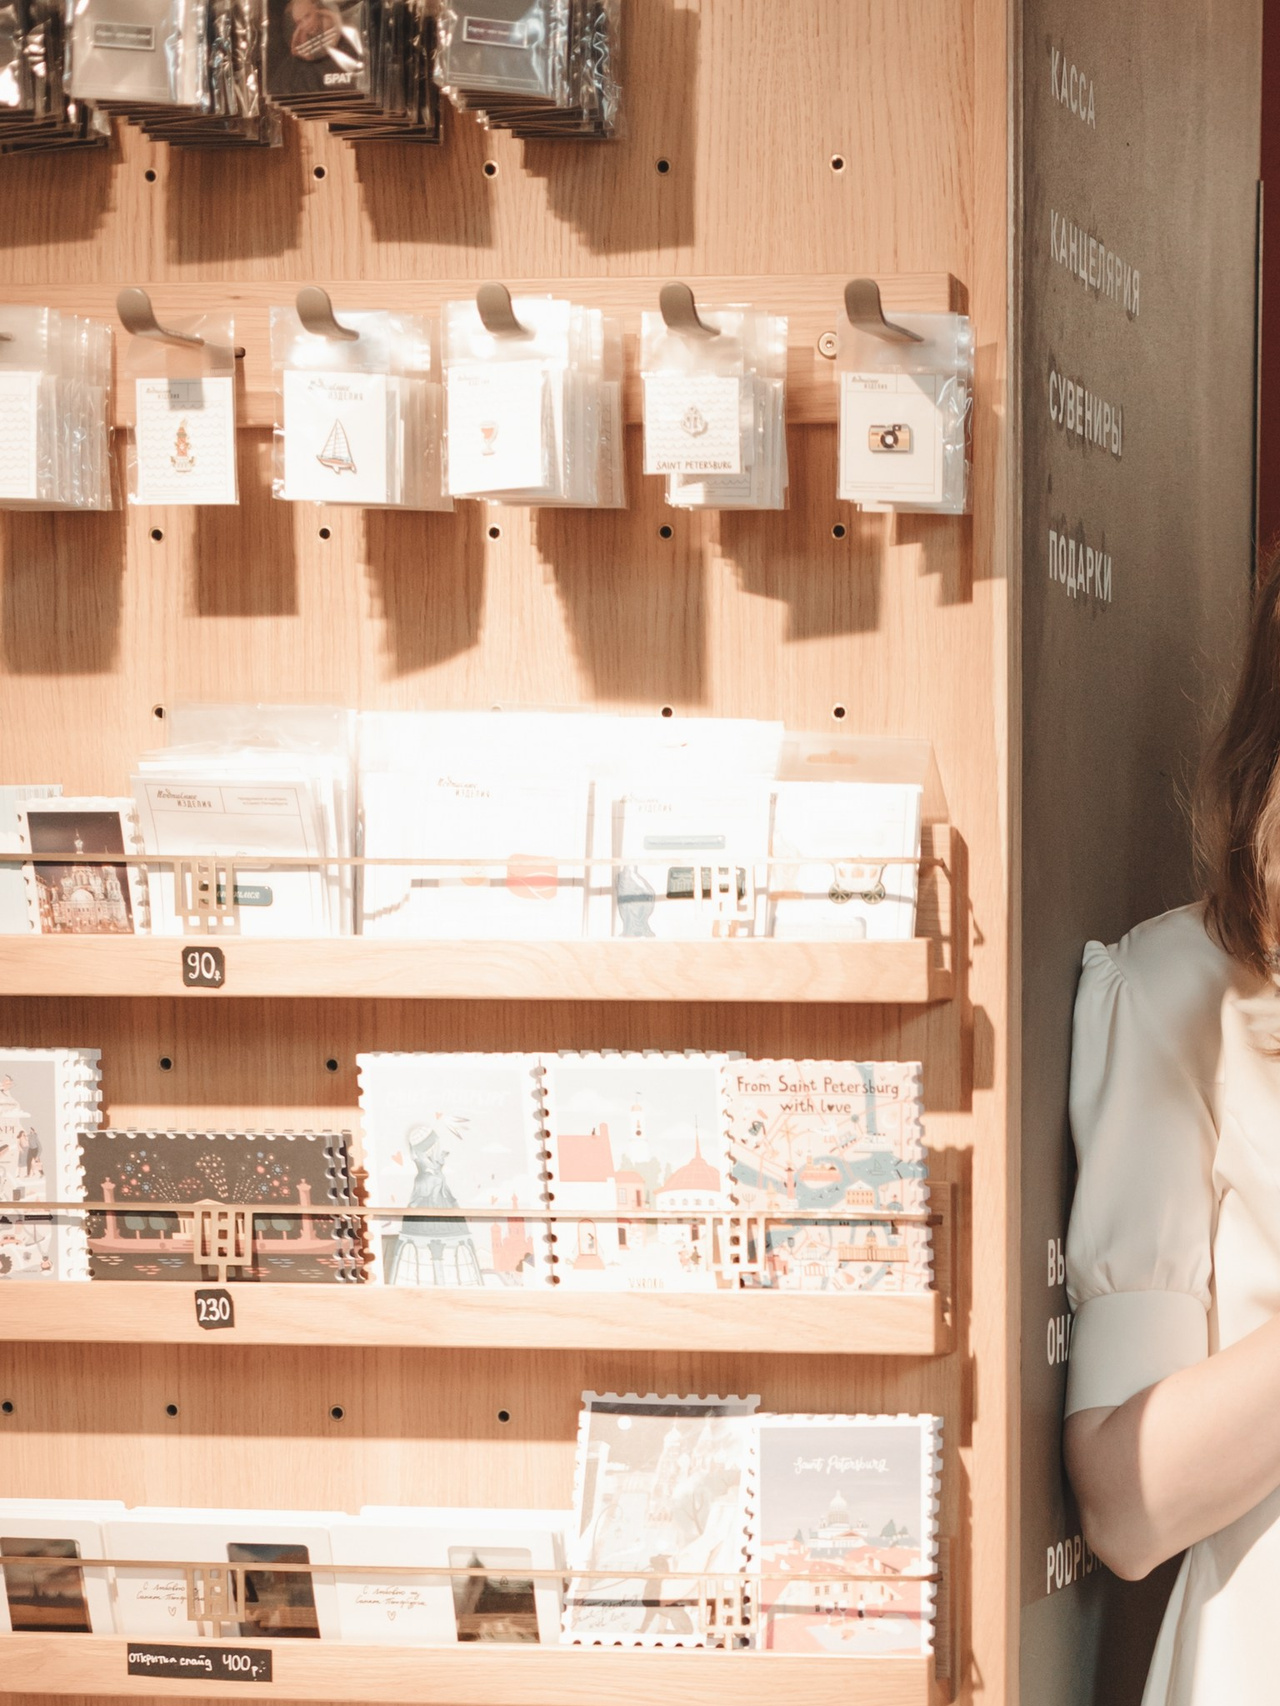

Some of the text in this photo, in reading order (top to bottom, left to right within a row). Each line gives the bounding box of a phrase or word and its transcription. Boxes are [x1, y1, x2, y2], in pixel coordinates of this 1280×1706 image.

[323, 72, 354, 86] БРАТ
[1051, 46, 1096, 129] КАССА
[1051, 209, 1140, 316] КАНЦЕЛЯРИЯ
[1049, 370, 1122, 456] СУВЕНИРЫ
[656, 461, 732, 471] SAINT PETERSBURG
[1049, 530, 1112, 602] ПОДАРКИ
[737, 1075, 899, 1099] From Saint Petersburg
[780, 1099, 814, 1113] with
[197, 1296, 230, 1321] 230
[793, 1455, 890, 1475] Saint Petersburg
